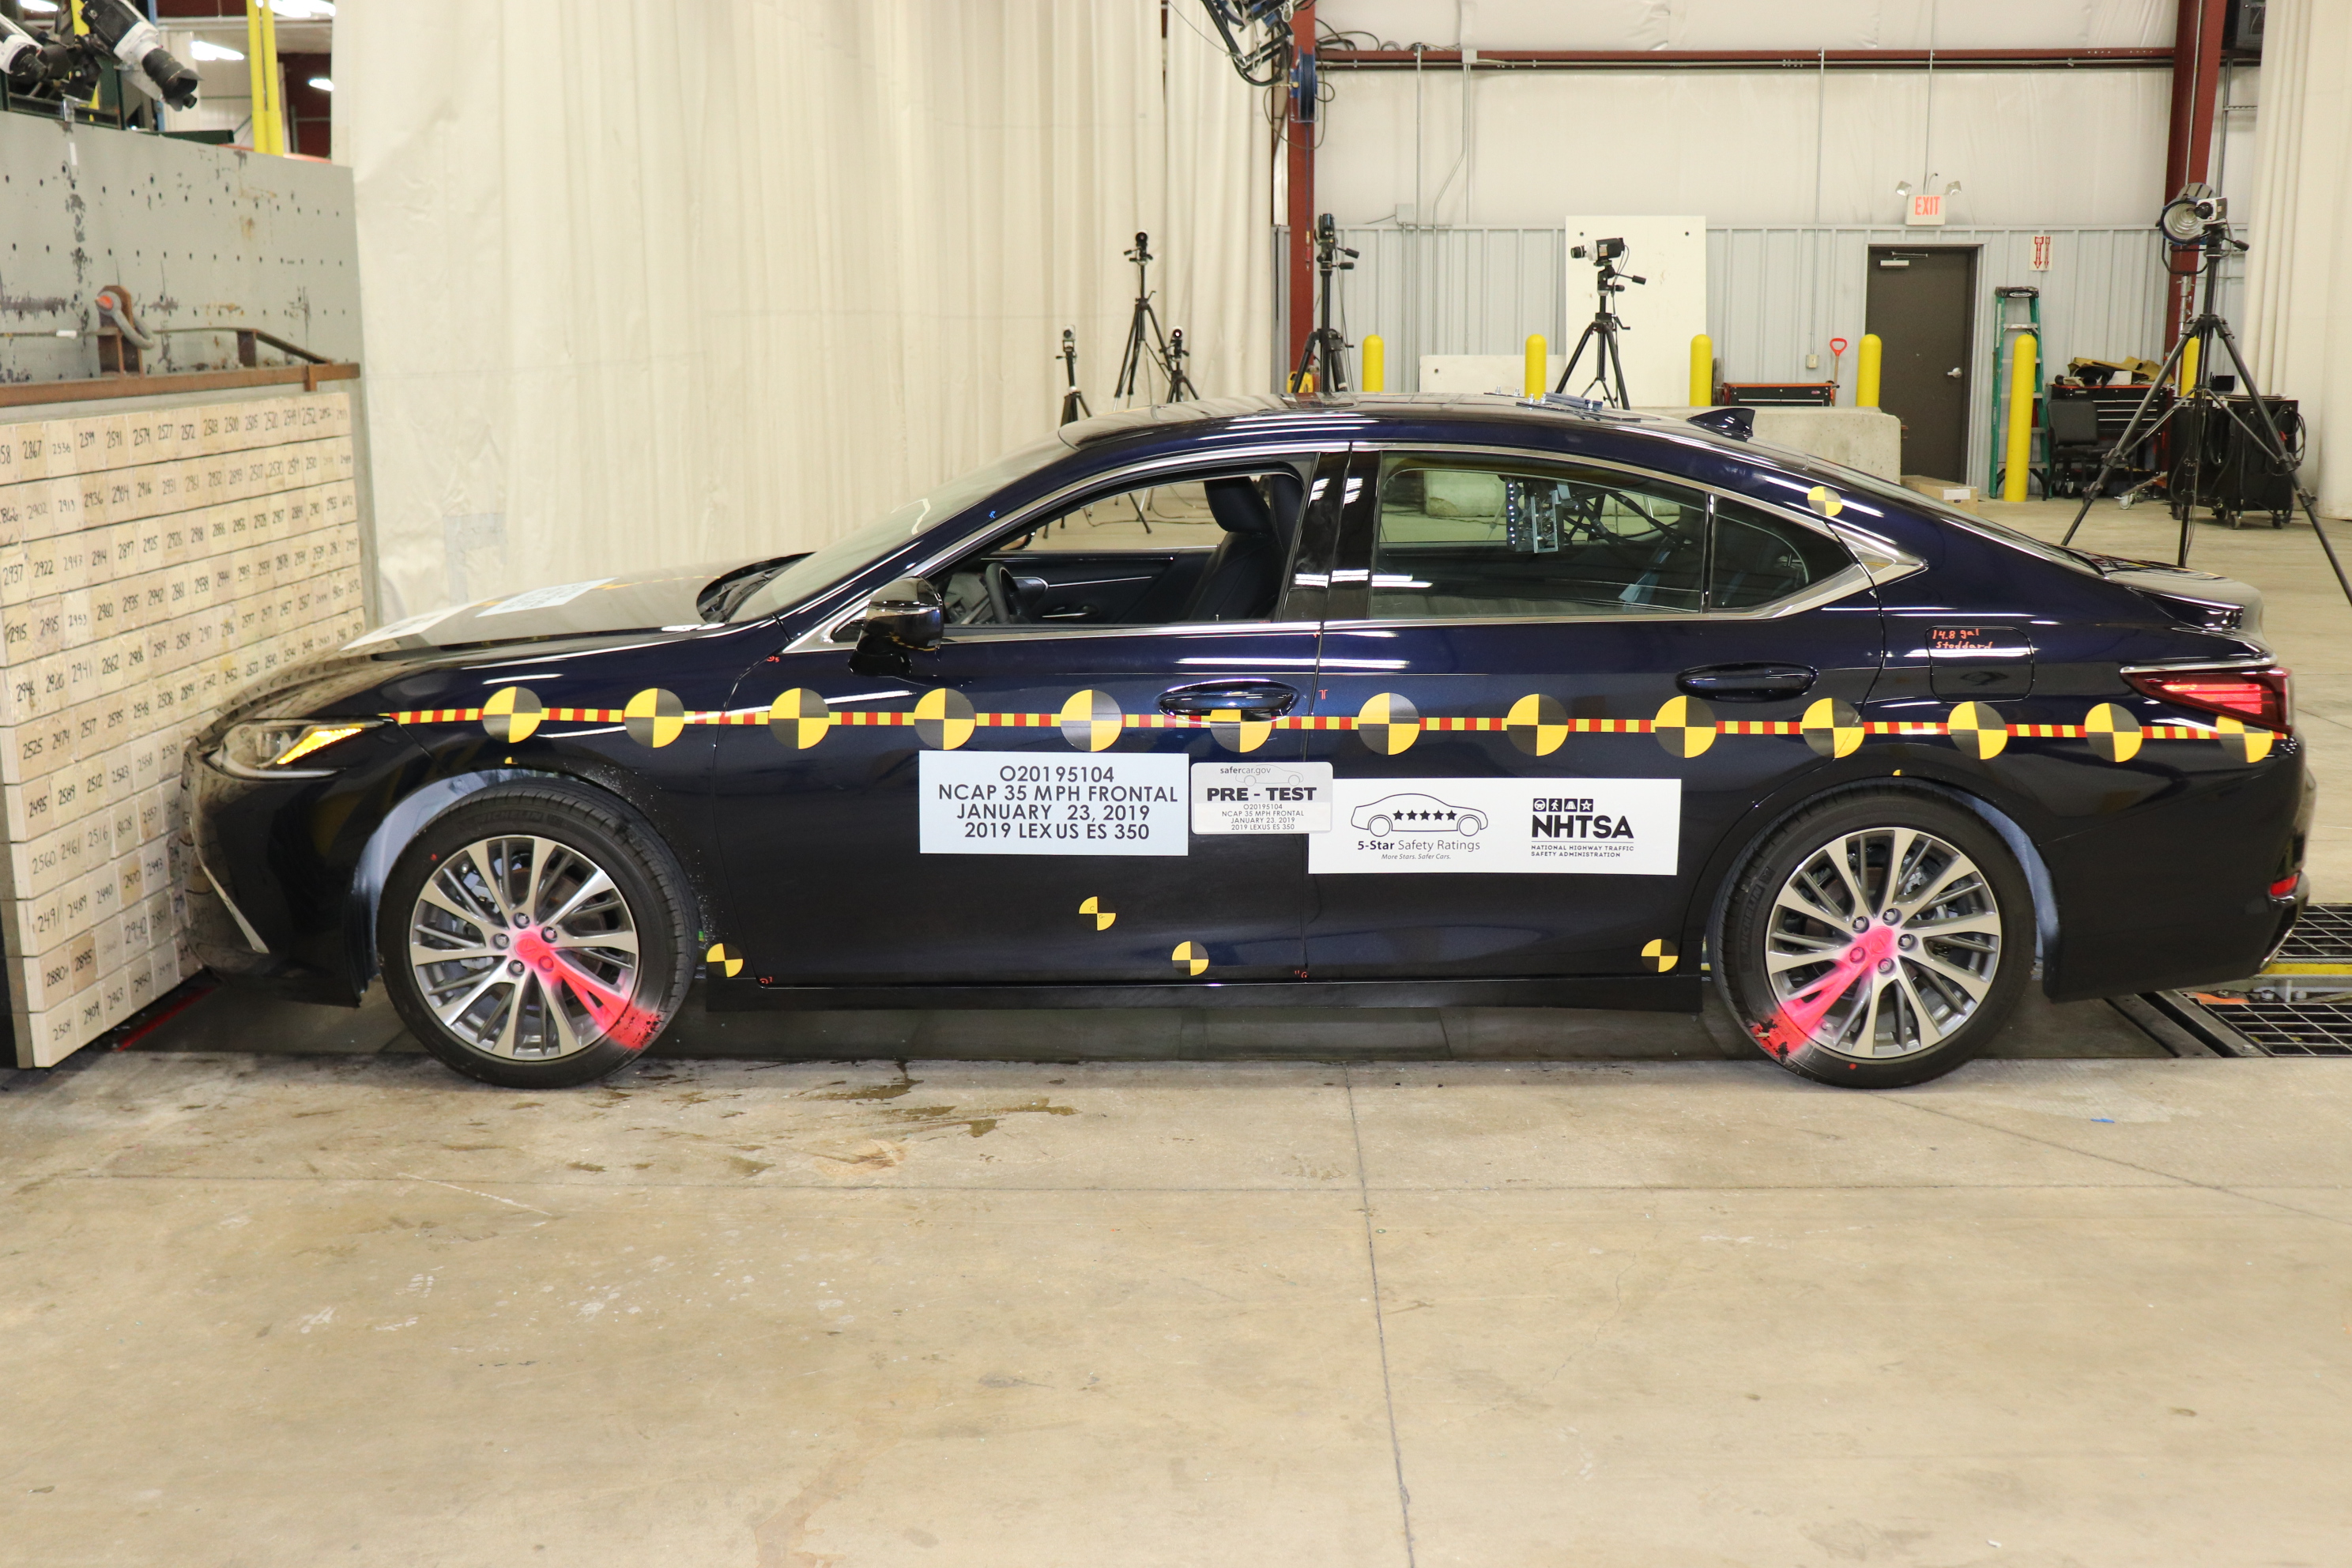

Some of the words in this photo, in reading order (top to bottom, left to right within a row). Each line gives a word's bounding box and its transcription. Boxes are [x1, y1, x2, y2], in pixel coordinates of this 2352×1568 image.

[1915, 196, 1941, 216] EXIT
[22, 440, 42, 459] 2867
[84, 491, 104, 507] 2936
[2, 564, 24, 586] 2937
[34, 560, 54, 578] 2922
[1932, 629, 1956, 639] 14.8
[1960, 628, 1979, 639] gal
[72, 659, 92, 683] 2941
[16, 680, 36, 702] 2946
[23, 738, 43, 760] 2525
[1219, 766, 1271, 776] safercar.gov
[87, 773, 103, 793] 2512
[58, 784, 75, 806] 2589
[938, 784, 997, 801] NCAP
[1004, 785, 1027, 801] 35
[1034, 786, 1080, 801] MPH
[1088, 786, 1178, 803] FRONTAL
[1207, 787, 1249, 801] PRE
[1265, 786, 1317, 801] TEST
[956, 805, 1051, 820] JANUARY
[1067, 805, 1096, 822] 23,
[1104, 806, 1150, 821] 2019
[88, 825, 108, 847] 2516
[964, 823, 1011, 839] 2019
[1019, 824, 1079, 839] LEXUS
[1087, 824, 1106, 839] ES
[1114, 824, 1150, 840] 350
[1532, 814, 1634, 839] NHTSA
[61, 837, 81, 861] 2461
[1357, 840, 1395, 850] 5-Star
[1398, 839, 1434, 853] Safety
[1437, 839, 1480, 853] Ratings
[32, 850, 57, 875] 2560
[67, 895, 87, 919] 2489
[38, 906, 61, 933] 2491
